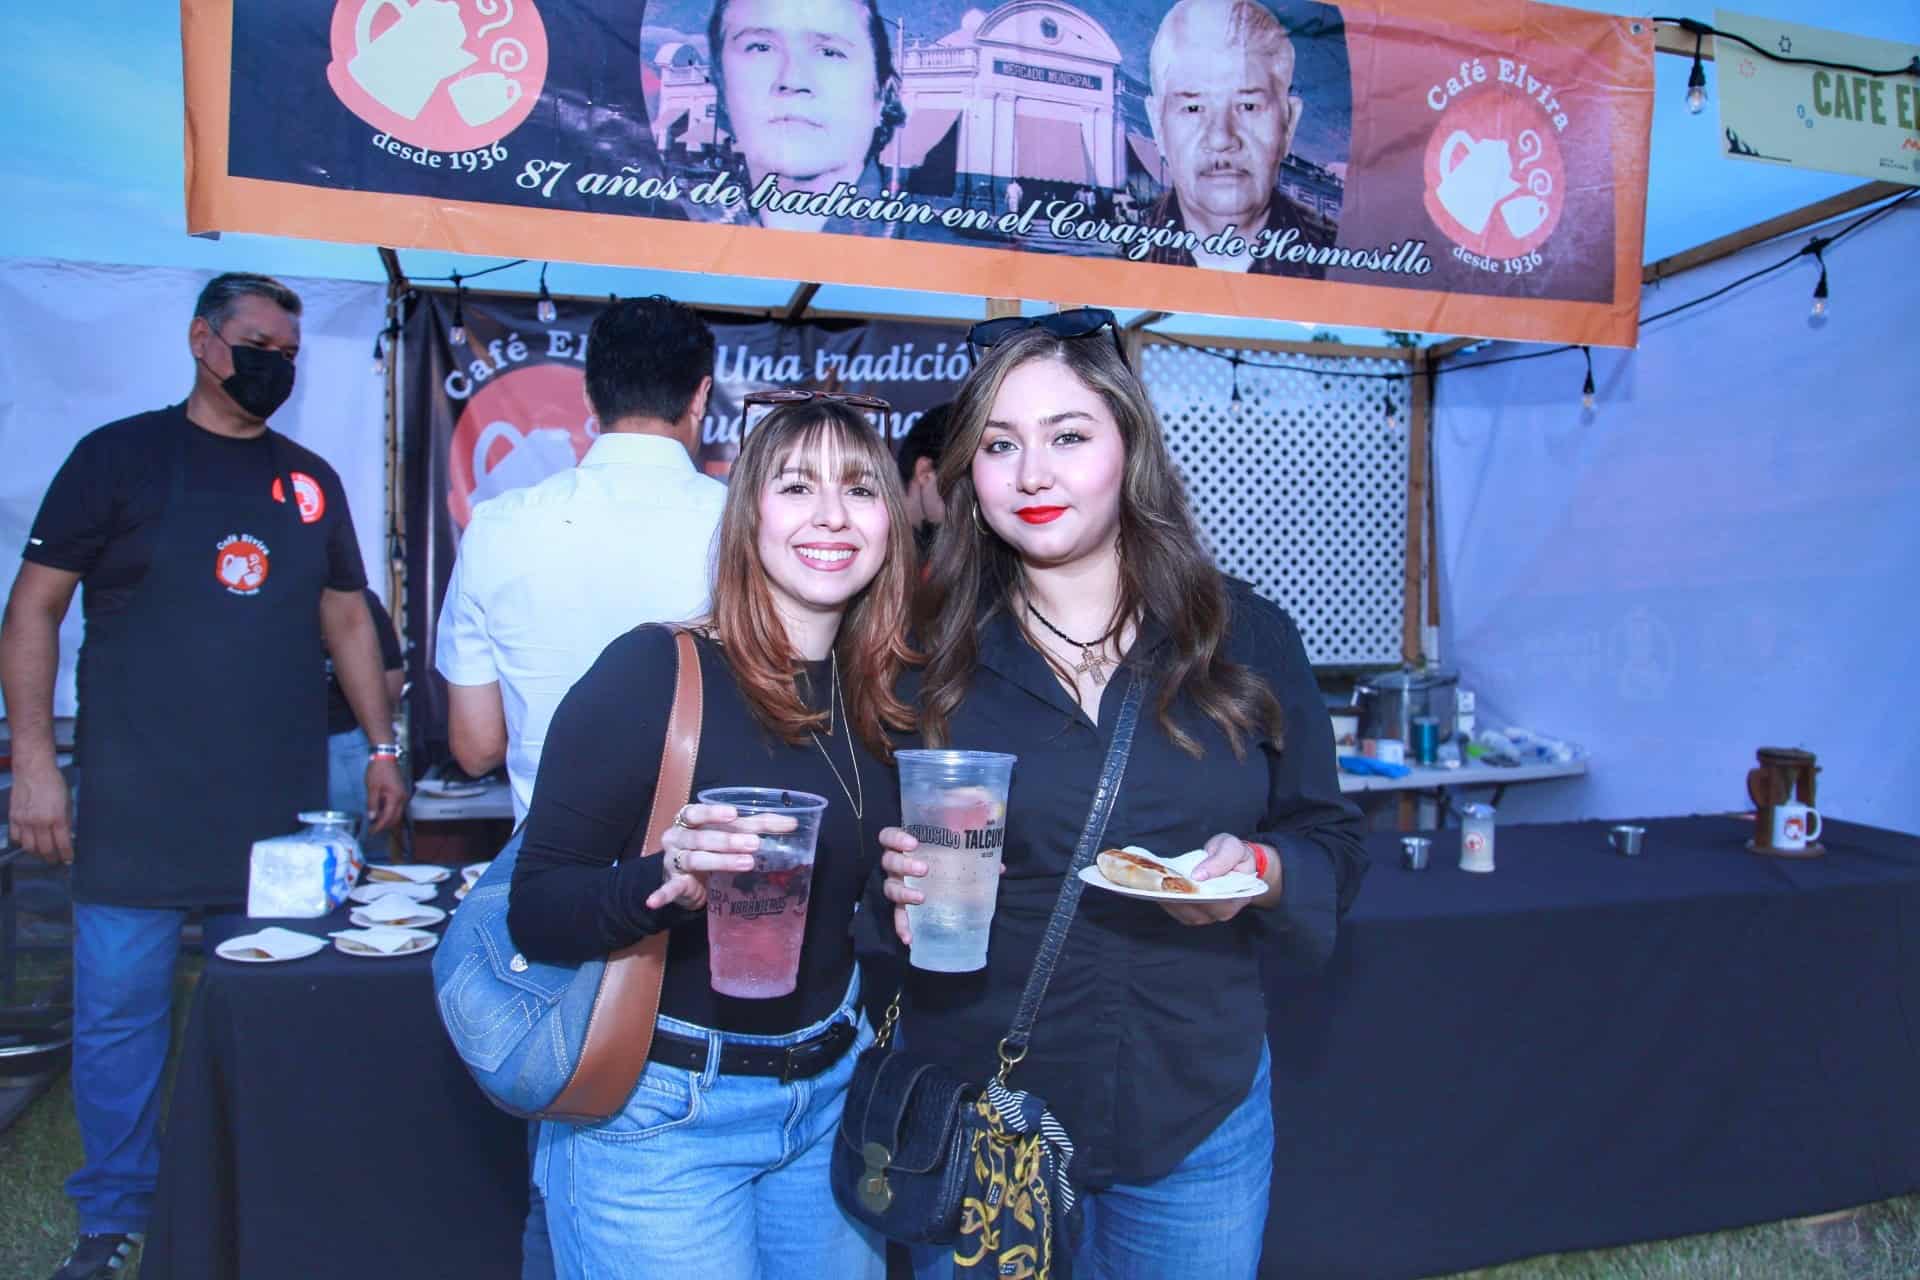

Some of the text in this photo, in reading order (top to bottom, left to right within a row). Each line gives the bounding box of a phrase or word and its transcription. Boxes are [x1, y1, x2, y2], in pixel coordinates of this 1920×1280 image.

[1427, 58, 1569, 132] Café Elvira
[1813, 70, 1887, 126] CAFE
[372, 131, 508, 173] desde 1936
[515, 158, 1433, 275] 87 años de tradición en el Corazón de Hermosillo
[1453, 245, 1543, 275] desde 1936
[444, 332, 528, 399] Café
[714, 343, 976, 382] Una tradició
